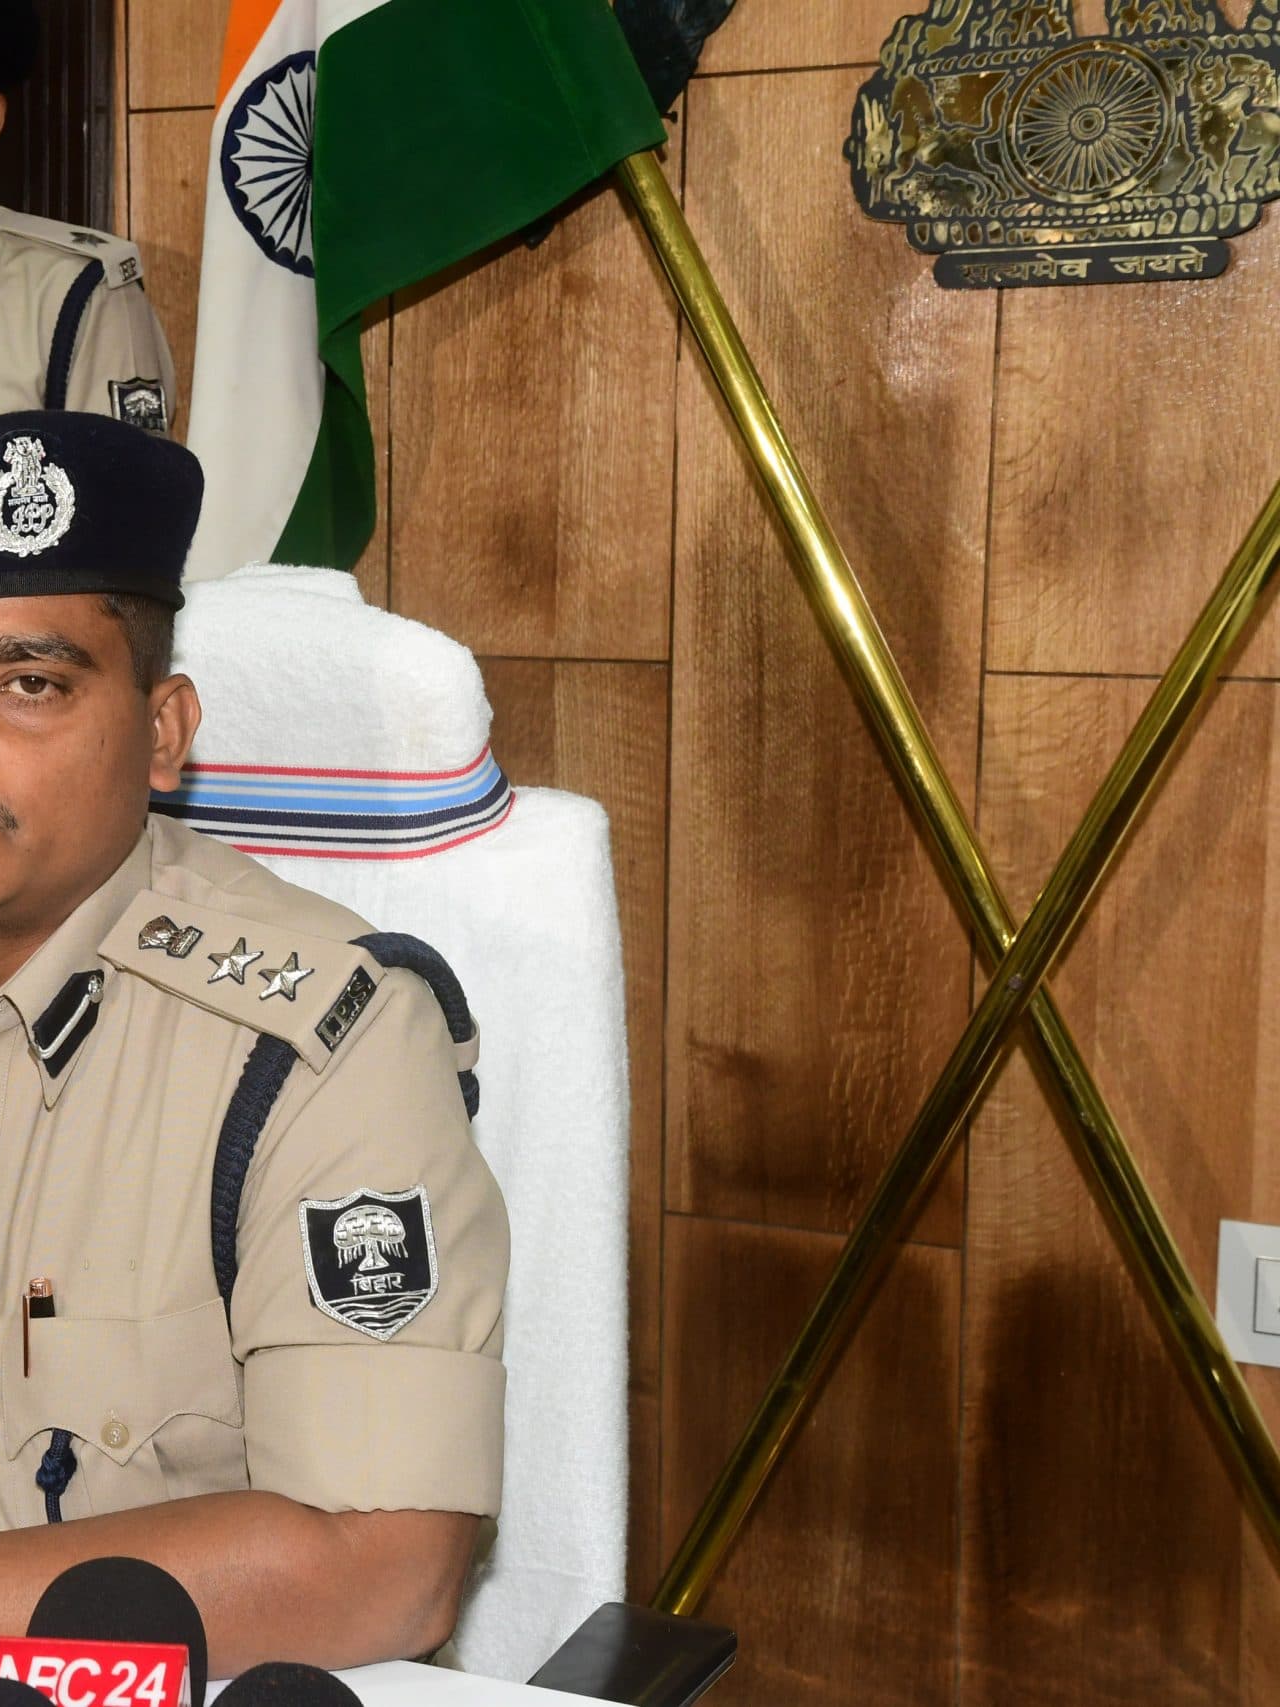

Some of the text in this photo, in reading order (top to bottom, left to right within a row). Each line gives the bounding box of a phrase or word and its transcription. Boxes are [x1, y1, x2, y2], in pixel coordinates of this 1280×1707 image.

[960, 246, 1208, 283] सत्यमेव जयते
[349, 1271, 406, 1296] बिहार
[102, 1660, 168, 1707] 24
